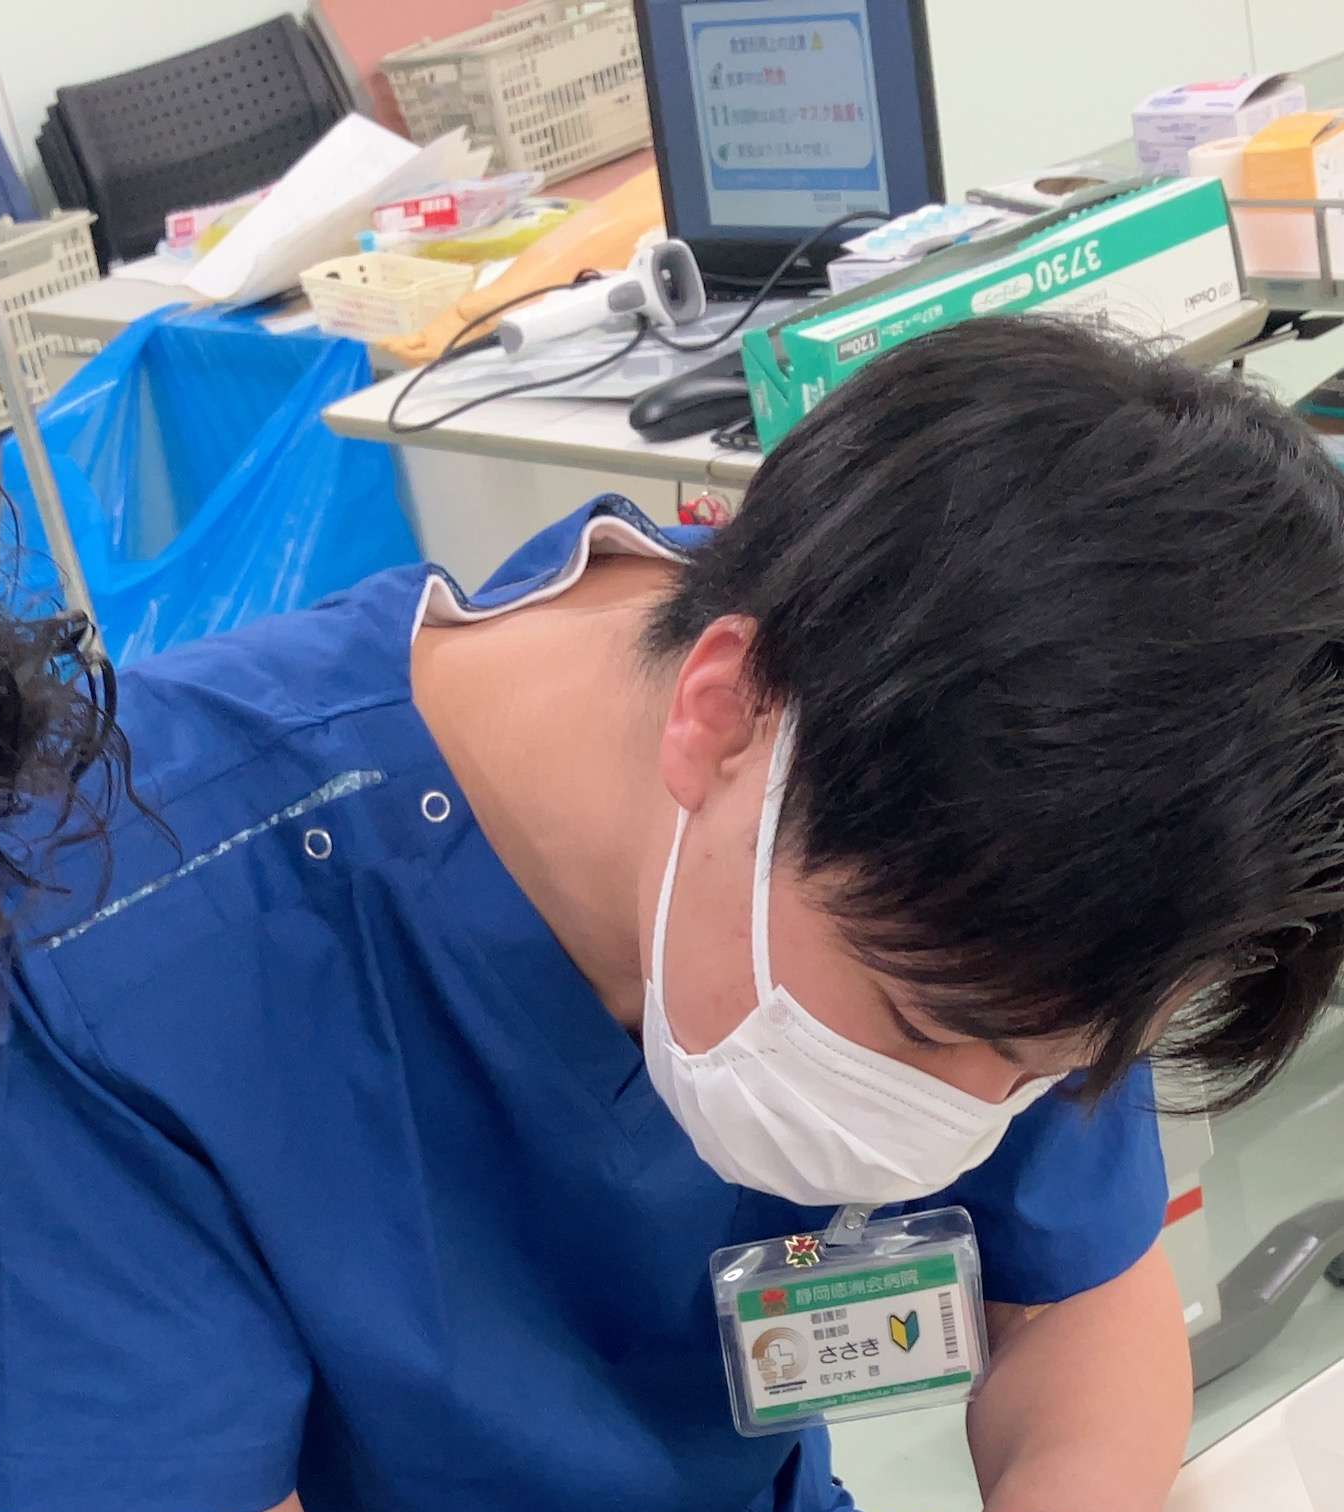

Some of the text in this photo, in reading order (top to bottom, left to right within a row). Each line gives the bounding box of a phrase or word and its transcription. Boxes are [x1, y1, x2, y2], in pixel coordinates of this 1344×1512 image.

[1035, 239, 1103, 292] 3730
[818, 1337, 880, 1364] ささき
[819, 1369, 857, 1386] 佐々木
